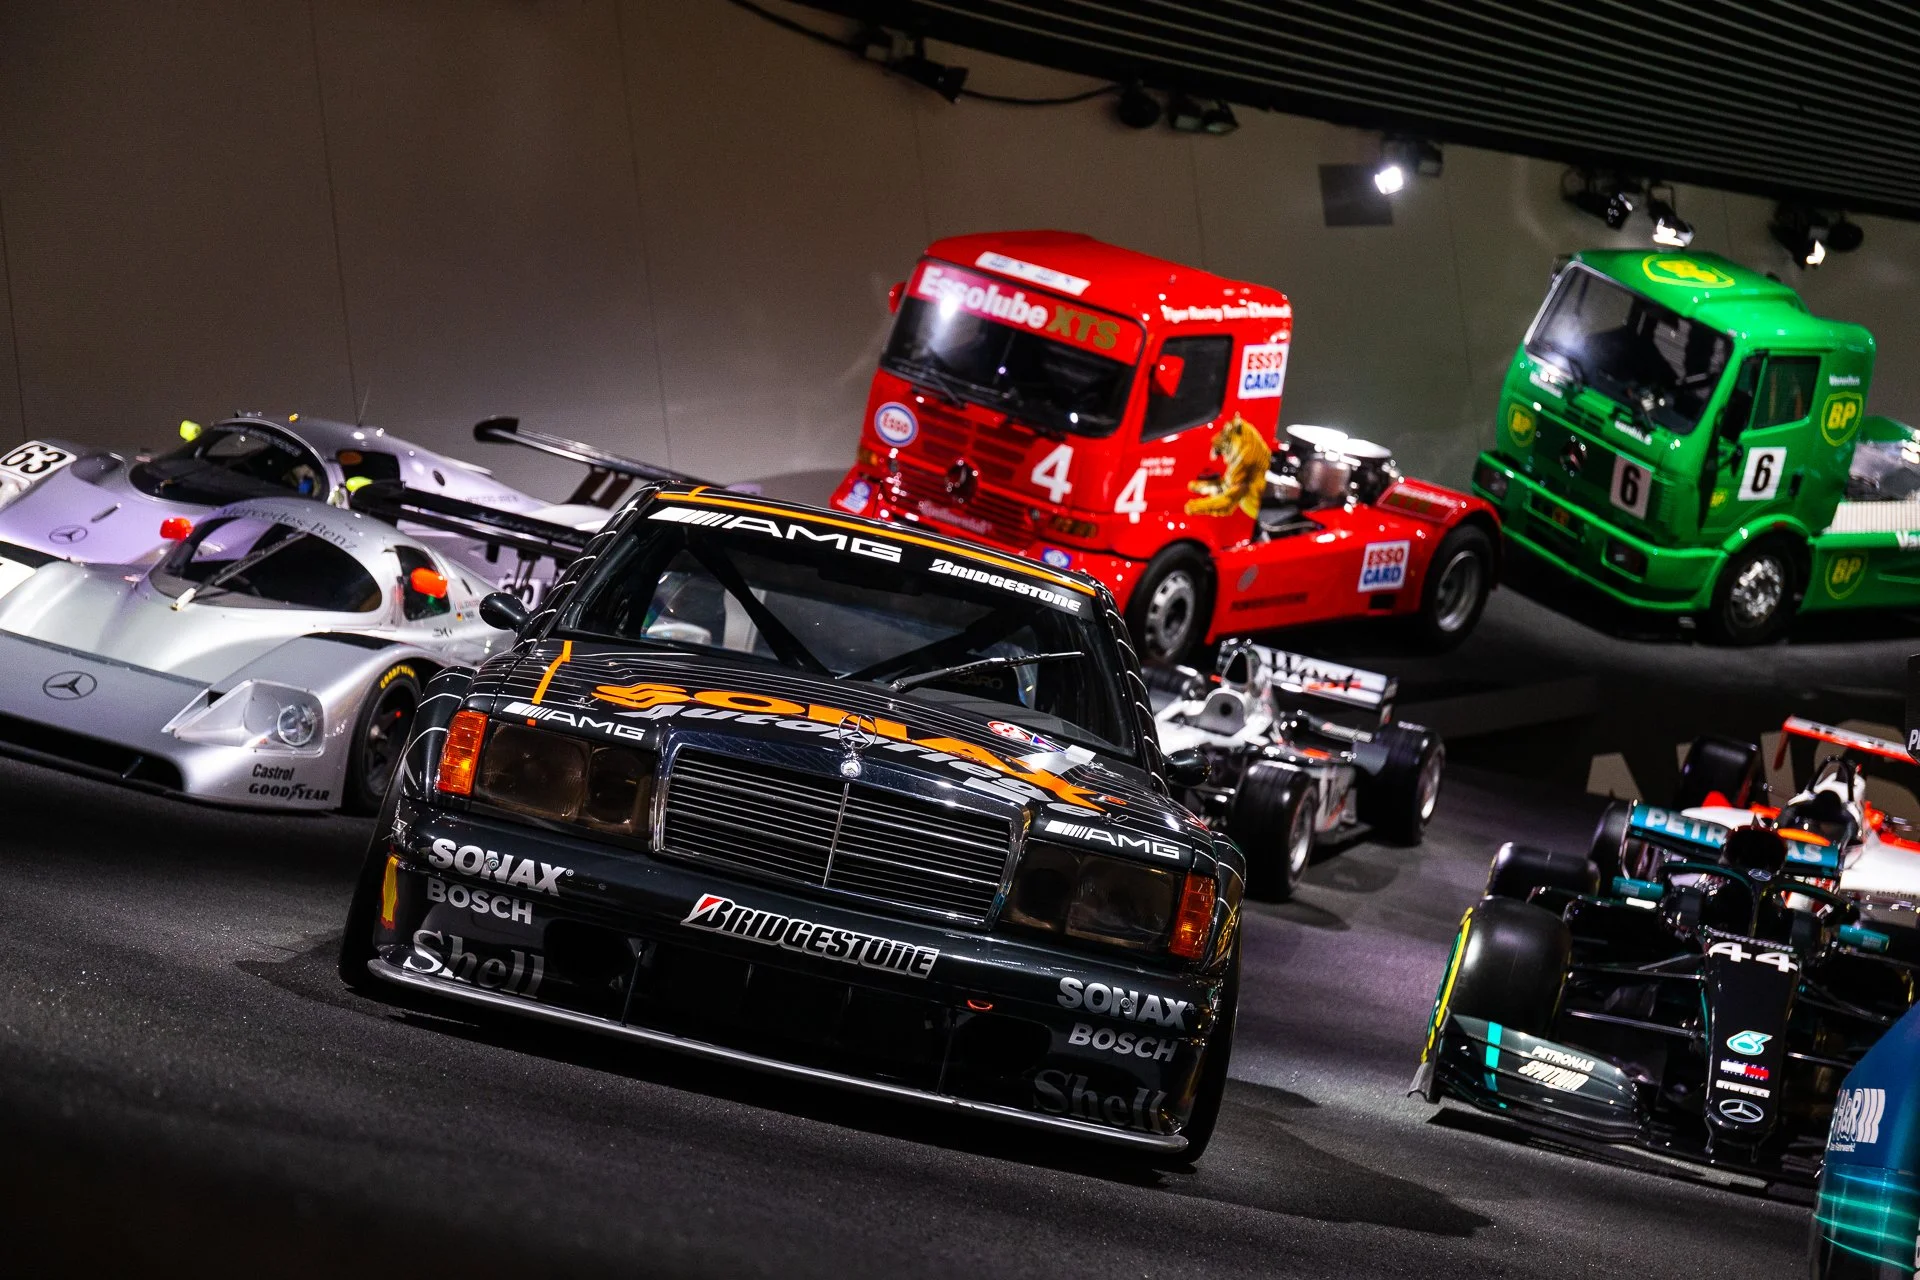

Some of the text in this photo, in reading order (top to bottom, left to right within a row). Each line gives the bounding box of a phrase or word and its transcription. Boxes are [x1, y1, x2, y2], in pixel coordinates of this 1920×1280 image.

[918, 265, 1048, 329] Essolube
[1046, 306, 1121, 349] XTS
[1246, 352, 1283, 370] ESSO
[1244, 372, 1280, 391] CARD
[882, 411, 911, 435] Esso
[1827, 402, 1857, 430] BP
[2, 445, 67, 475] 63
[1031, 444, 1074, 504] 4
[1752, 453, 1775, 494] 6
[1114, 467, 1148, 524] 4
[1620, 464, 1641, 507] 6
[1368, 548, 1404, 567] ESSO
[1831, 557, 1862, 585] BP
[928, 558, 1082, 613] BRIDGESTONE
[1362, 567, 1401, 586] CARD
[380, 664, 415, 690] GOODYEAR
[590, 683, 1106, 812] SONAX
[252, 763, 296, 781] Castrol
[249, 783, 330, 801] GOODYEAR
[1645, 806, 1823, 863] PETRAS
[427, 877, 533, 925] BOSCH
[681, 894, 940, 979] BRIDGESTONE
[402, 929, 546, 999] Shell
[1708, 941, 1799, 973] 44
[1068, 1022, 1179, 1062] BOSCH
[1531, 1045, 1595, 1072] PETRONAS
[1033, 1069, 1167, 1136] Shell
